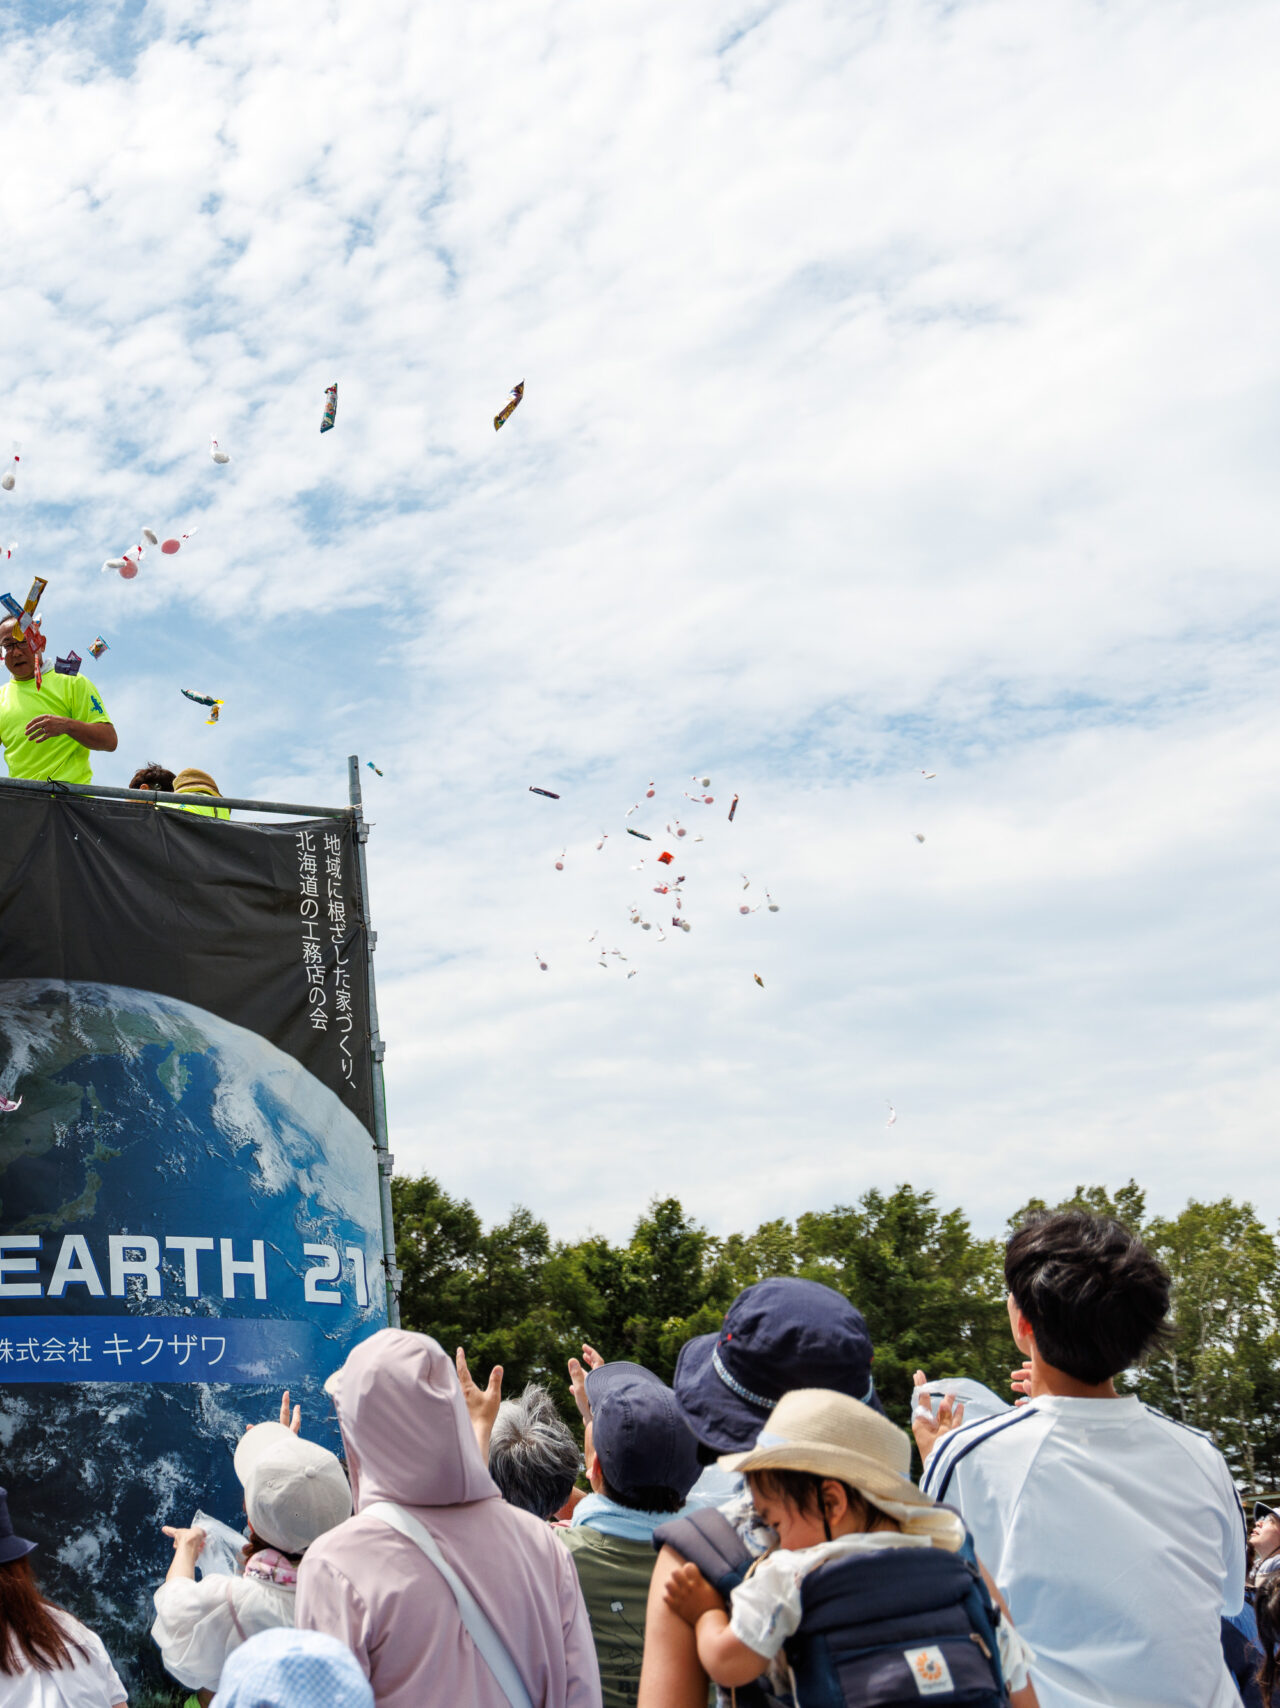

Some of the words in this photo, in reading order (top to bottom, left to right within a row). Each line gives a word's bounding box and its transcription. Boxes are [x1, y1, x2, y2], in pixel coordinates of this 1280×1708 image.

[295, 831, 329, 1031] 北海道の工務店の会
[323, 832, 357, 1089] 地域に根ざした家づくり、
[303, 1242, 369, 1308] 21
[102, 1332, 227, 1367] キクザワ
